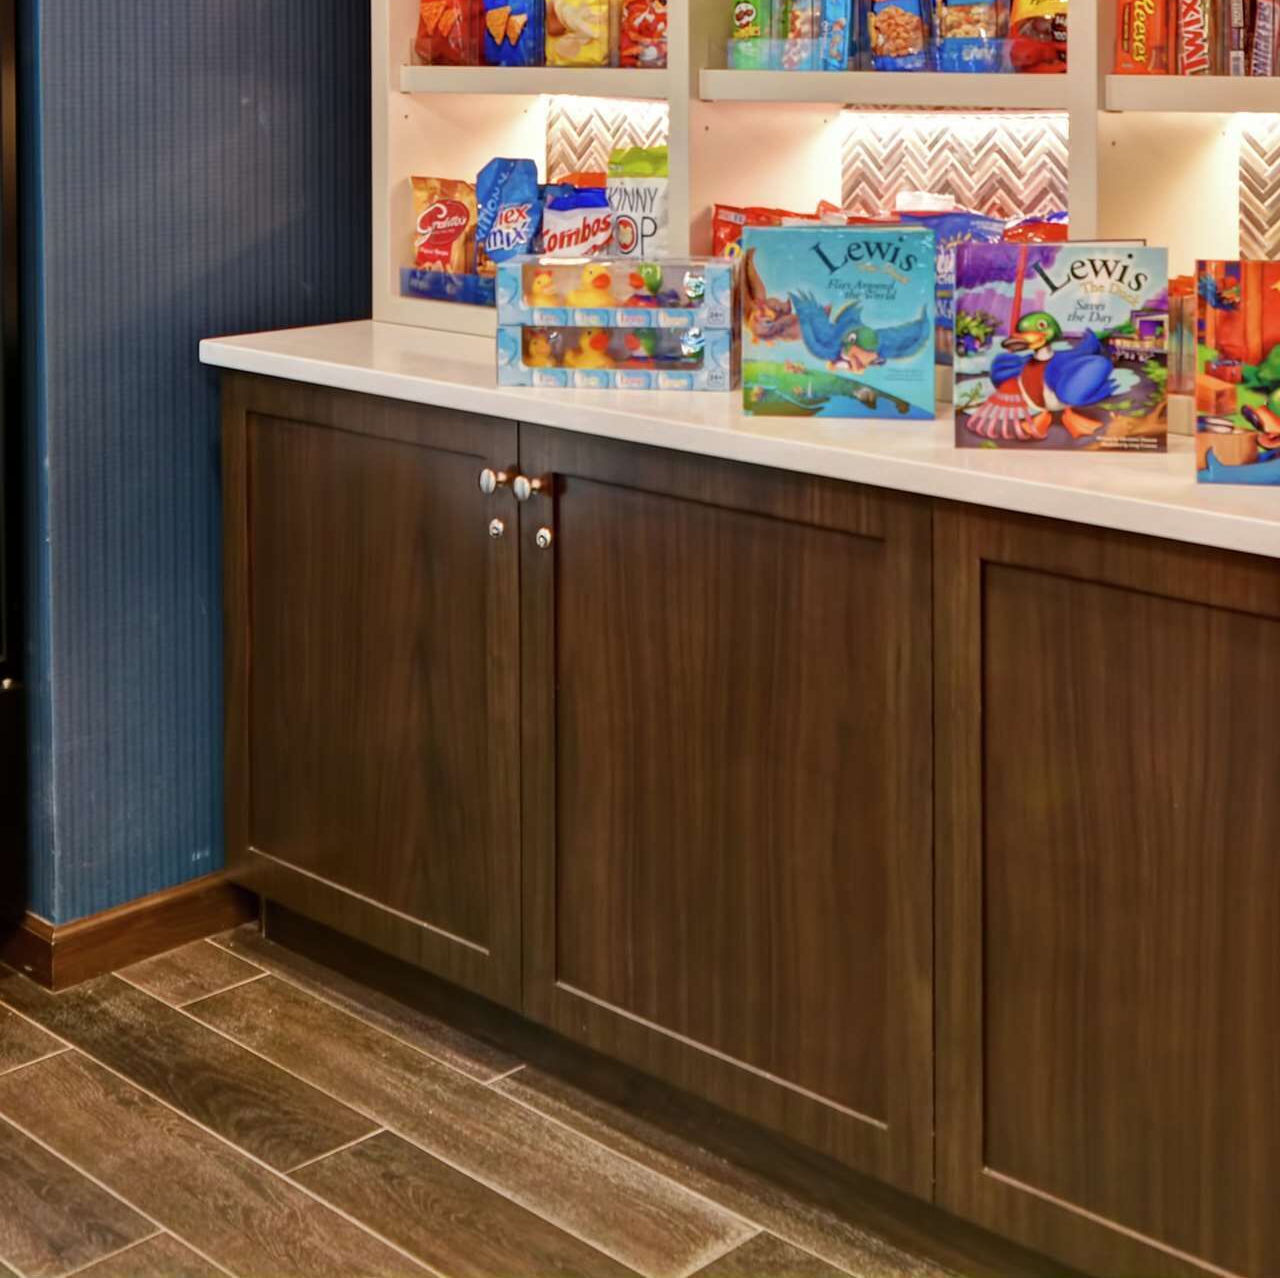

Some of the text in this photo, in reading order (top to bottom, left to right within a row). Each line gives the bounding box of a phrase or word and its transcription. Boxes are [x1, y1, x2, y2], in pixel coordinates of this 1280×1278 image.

[606, 186, 659, 215] KINNY
[612, 216, 658, 257] OP
[810, 236, 919, 276] Lewis
[1031, 252, 1149, 296] Lewis
[1066, 310, 1114, 325] the Day
[1075, 298, 1107, 312] Saves
